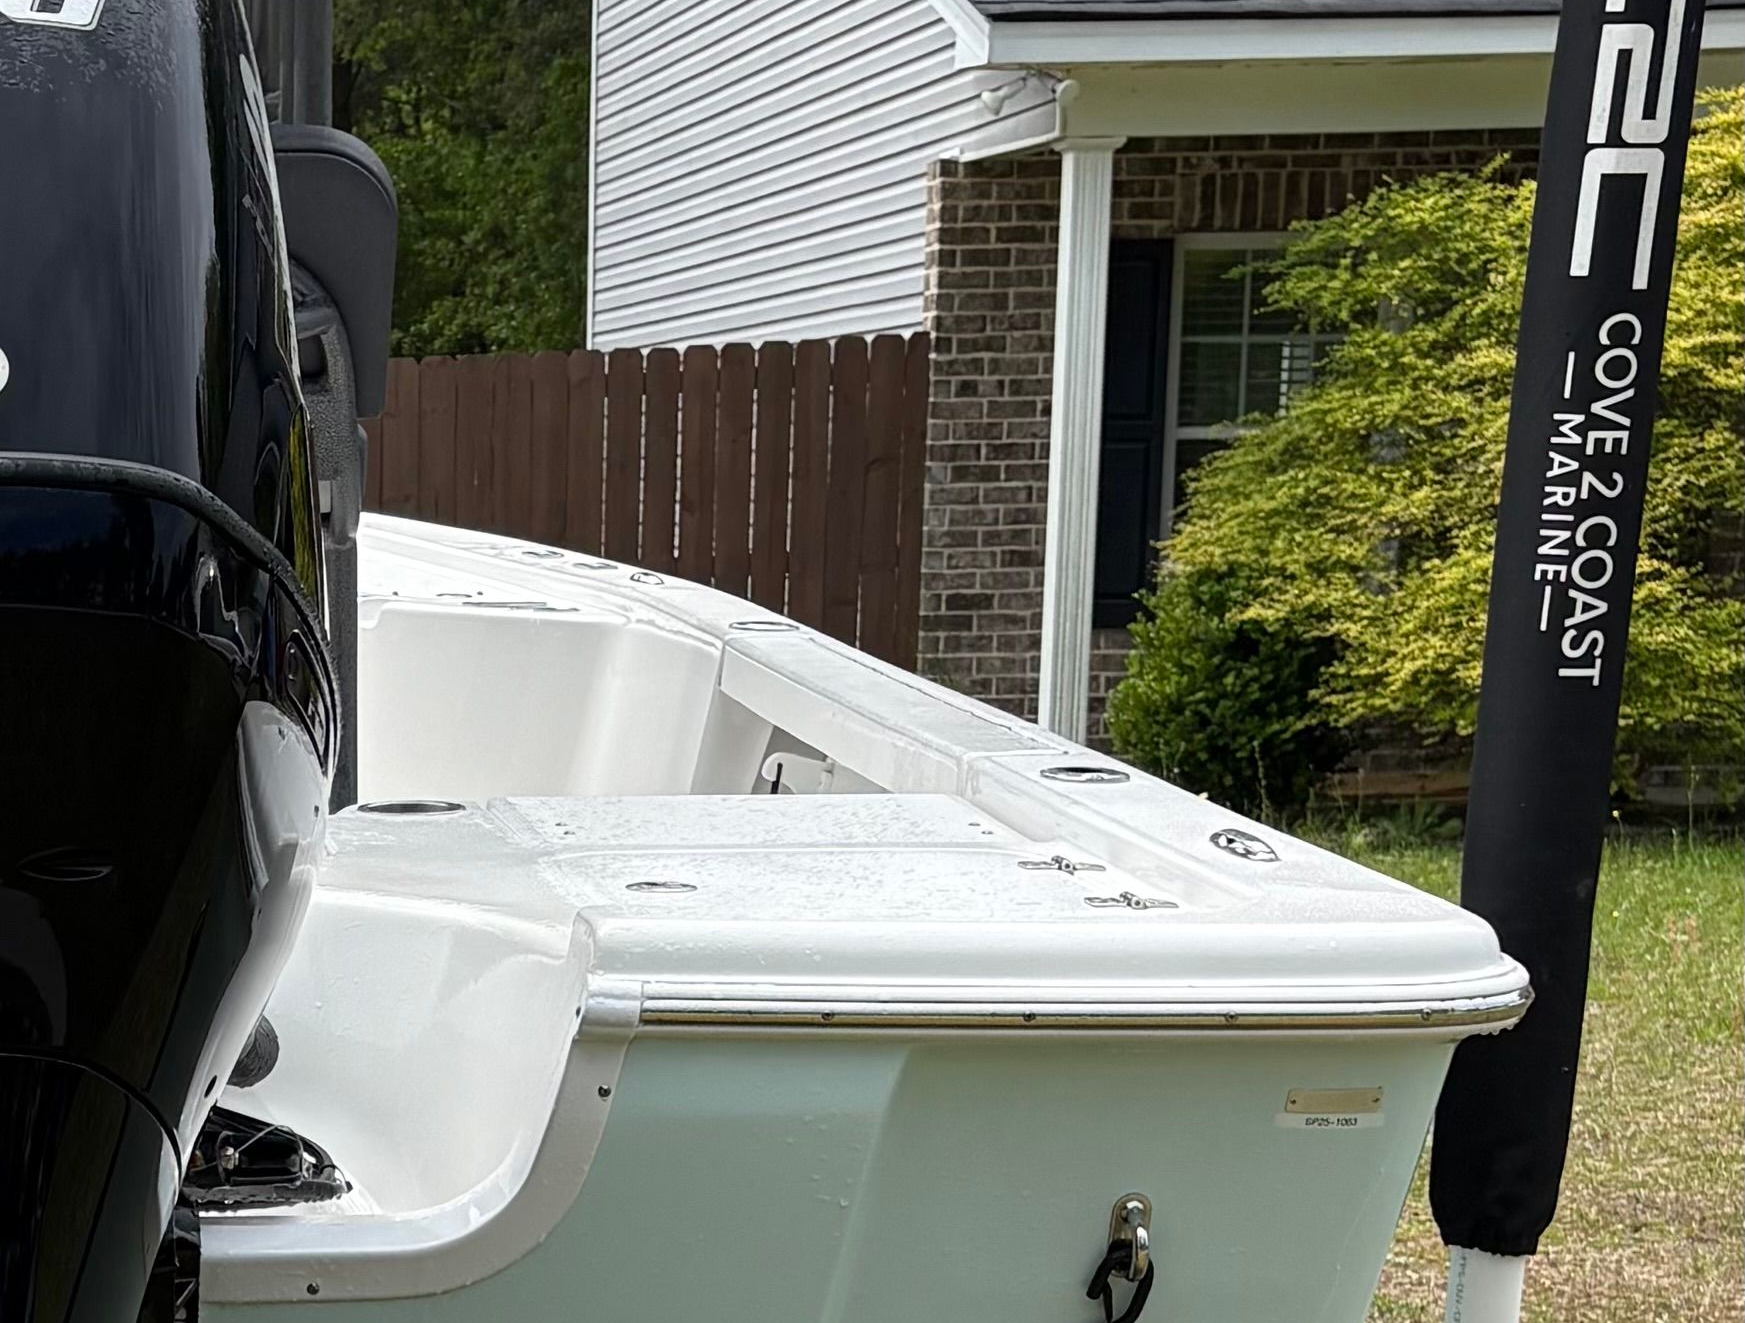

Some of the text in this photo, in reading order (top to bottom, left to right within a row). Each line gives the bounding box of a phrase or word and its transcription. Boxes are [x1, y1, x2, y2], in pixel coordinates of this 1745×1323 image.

[1534, 412, 1586, 583] MARINE
[1558, 312, 1642, 686] COVE 2 COAST
